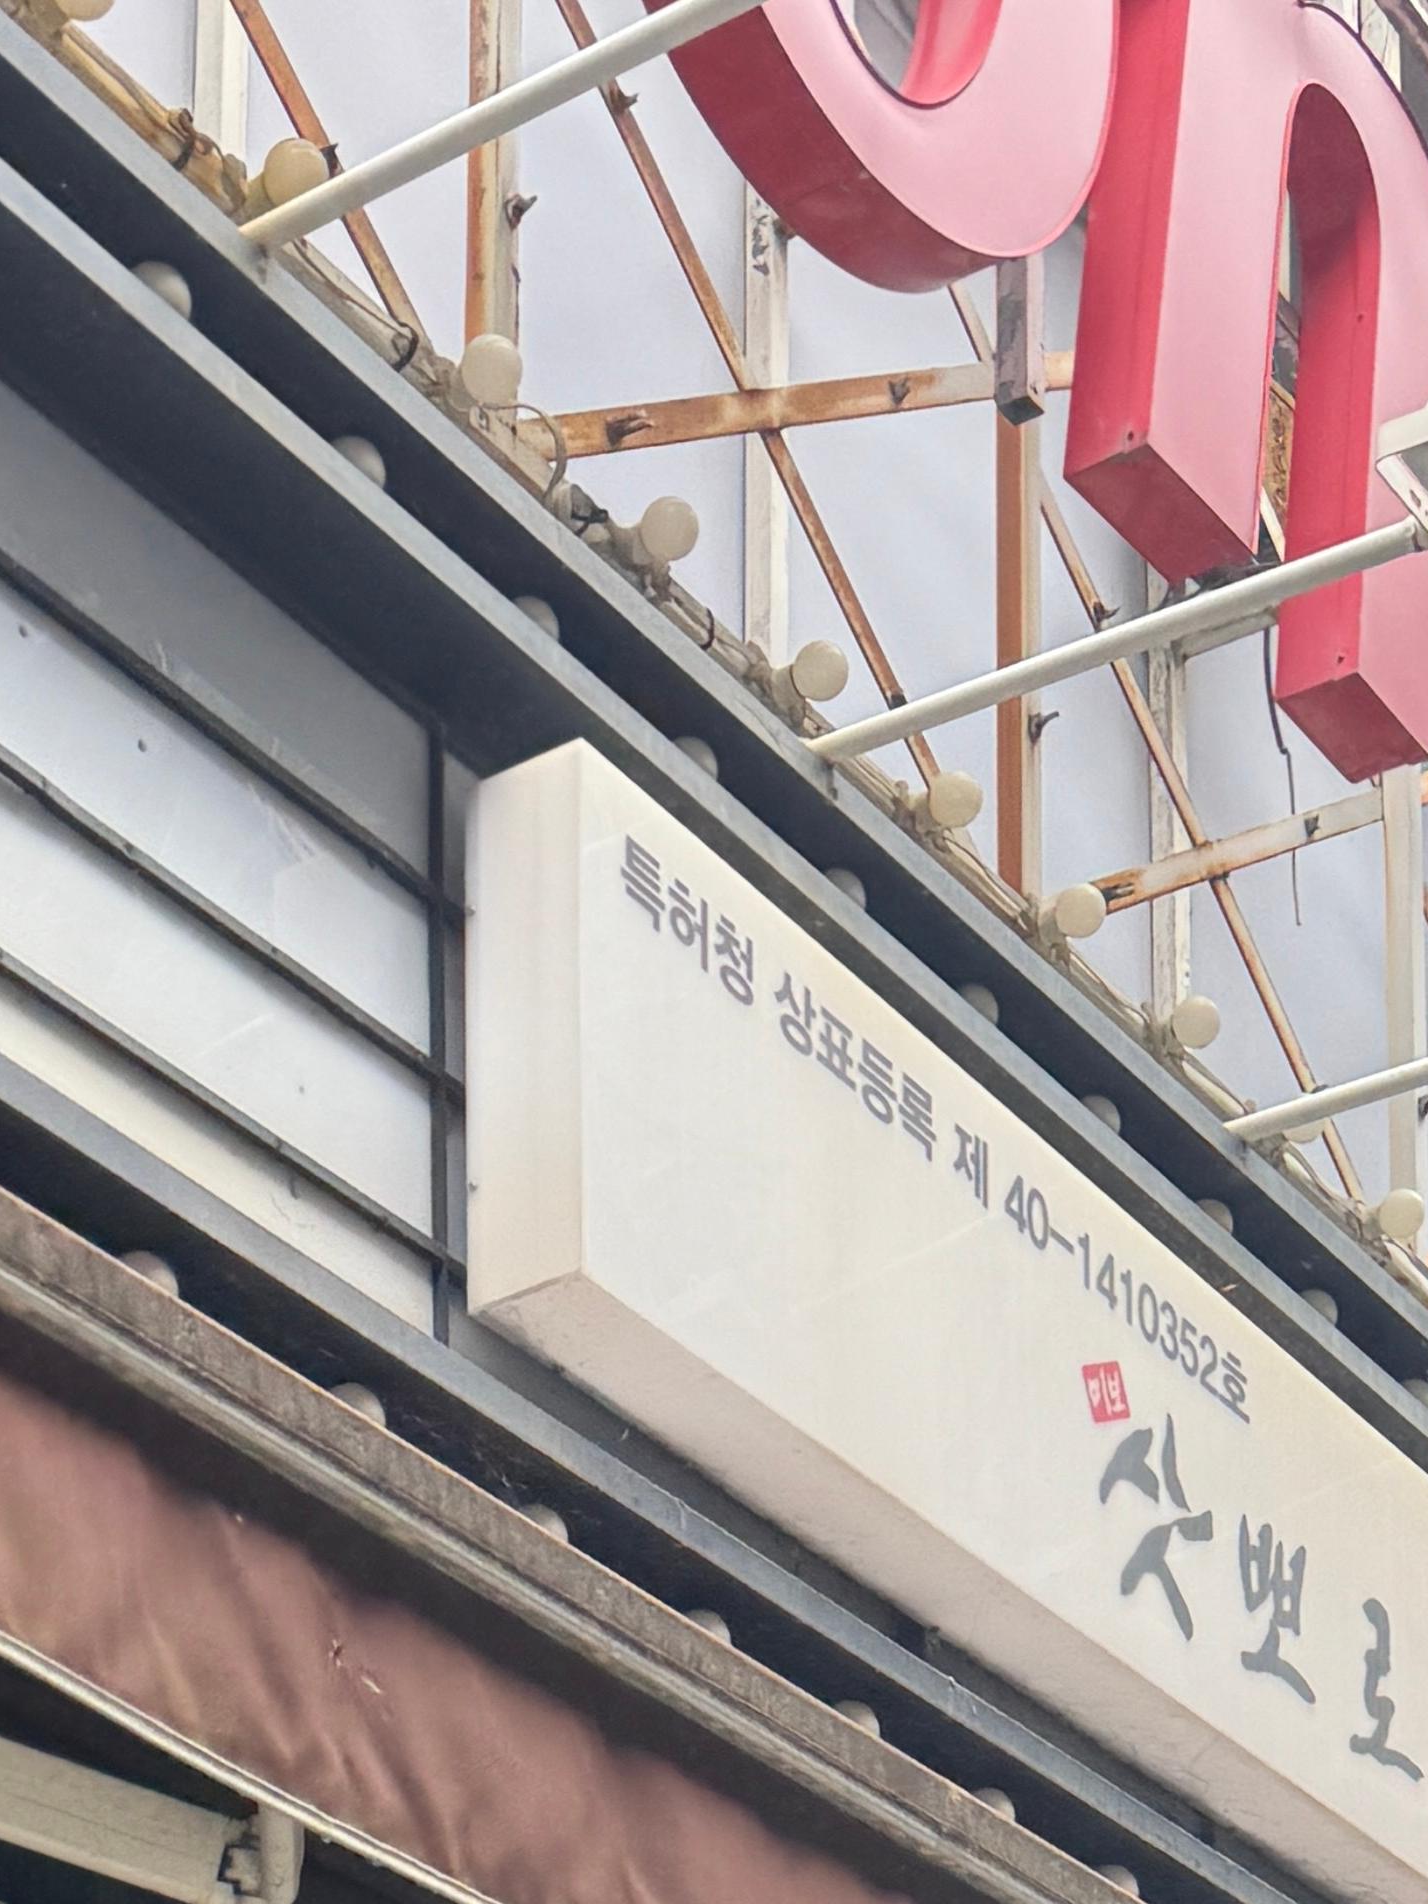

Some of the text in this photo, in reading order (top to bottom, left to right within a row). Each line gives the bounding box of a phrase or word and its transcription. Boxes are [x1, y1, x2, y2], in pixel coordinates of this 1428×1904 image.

[620, 835, 1251, 1424] 특허청 상표등록 제 40-1410352호
